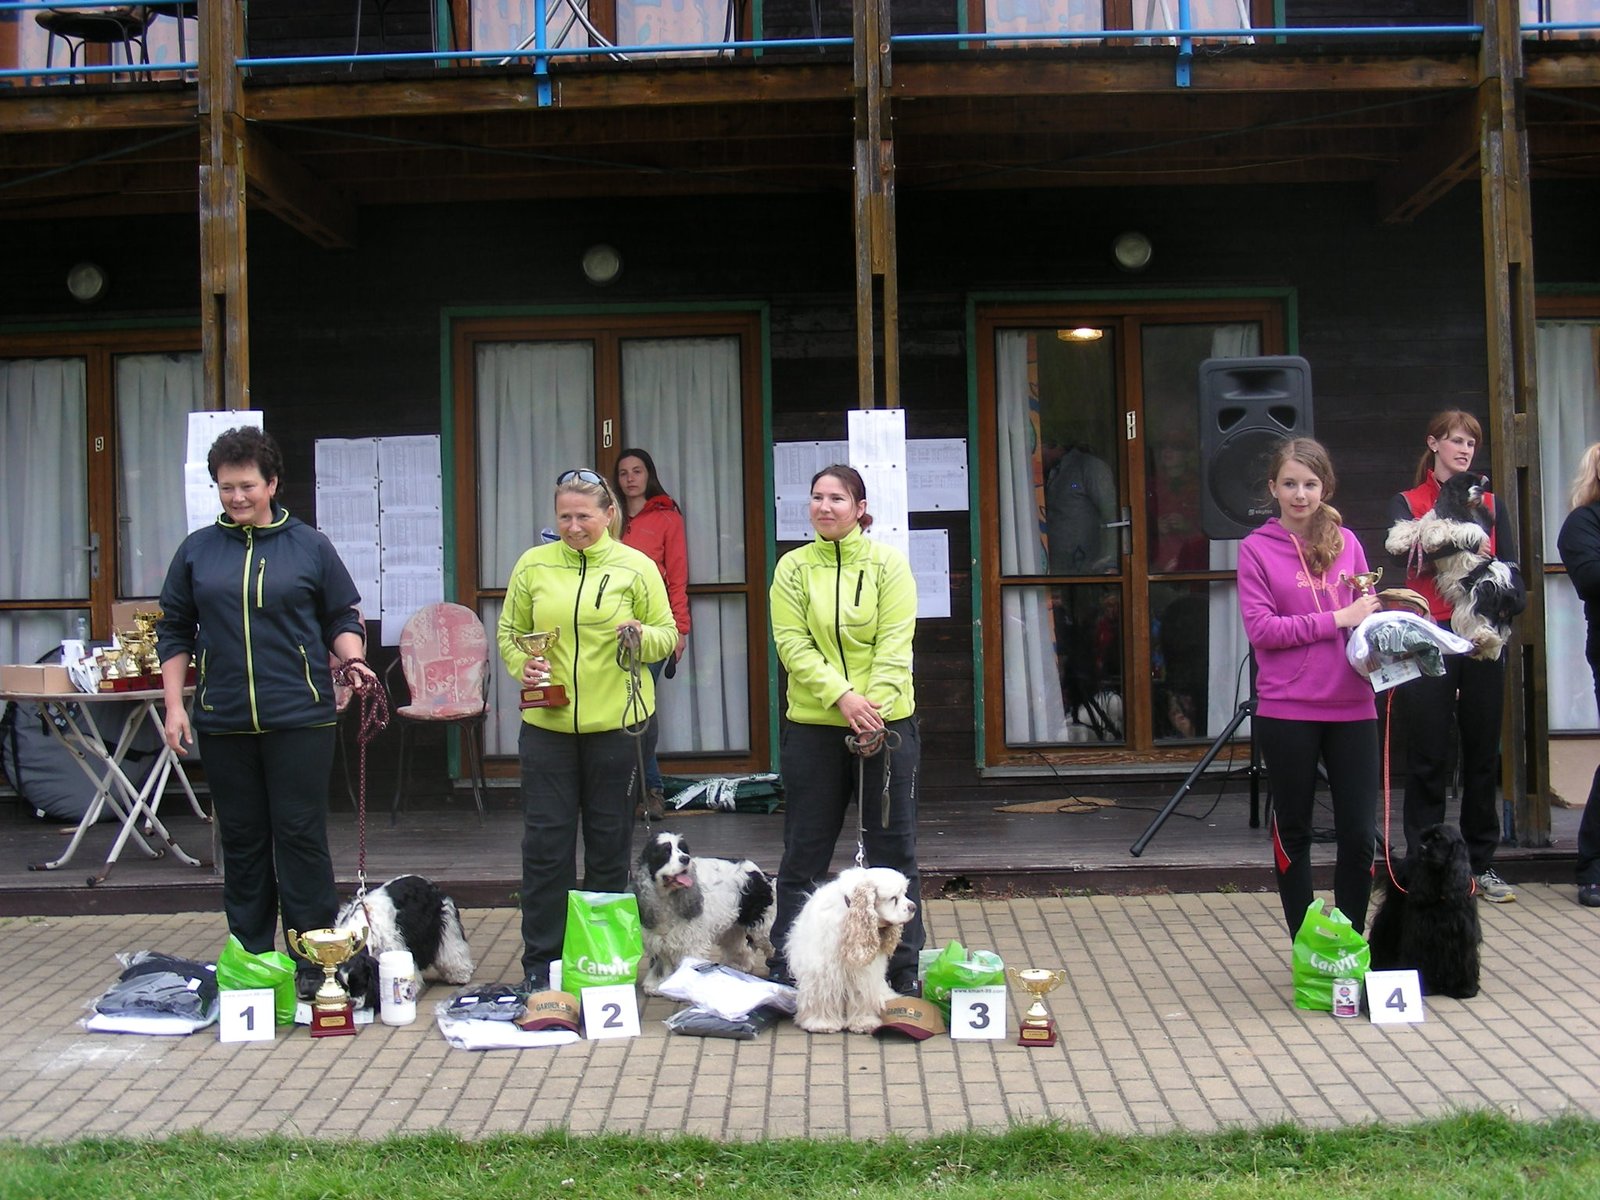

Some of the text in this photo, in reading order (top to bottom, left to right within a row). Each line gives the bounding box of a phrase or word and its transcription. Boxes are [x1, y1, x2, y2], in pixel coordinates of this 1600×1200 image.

[96, 438, 103, 450] 9
[1385, 987, 1407, 1012] 4
[240, 1006, 254, 1031] 1
[601, 1003, 624, 1028] 2
[969, 1003, 991, 1029] 3
